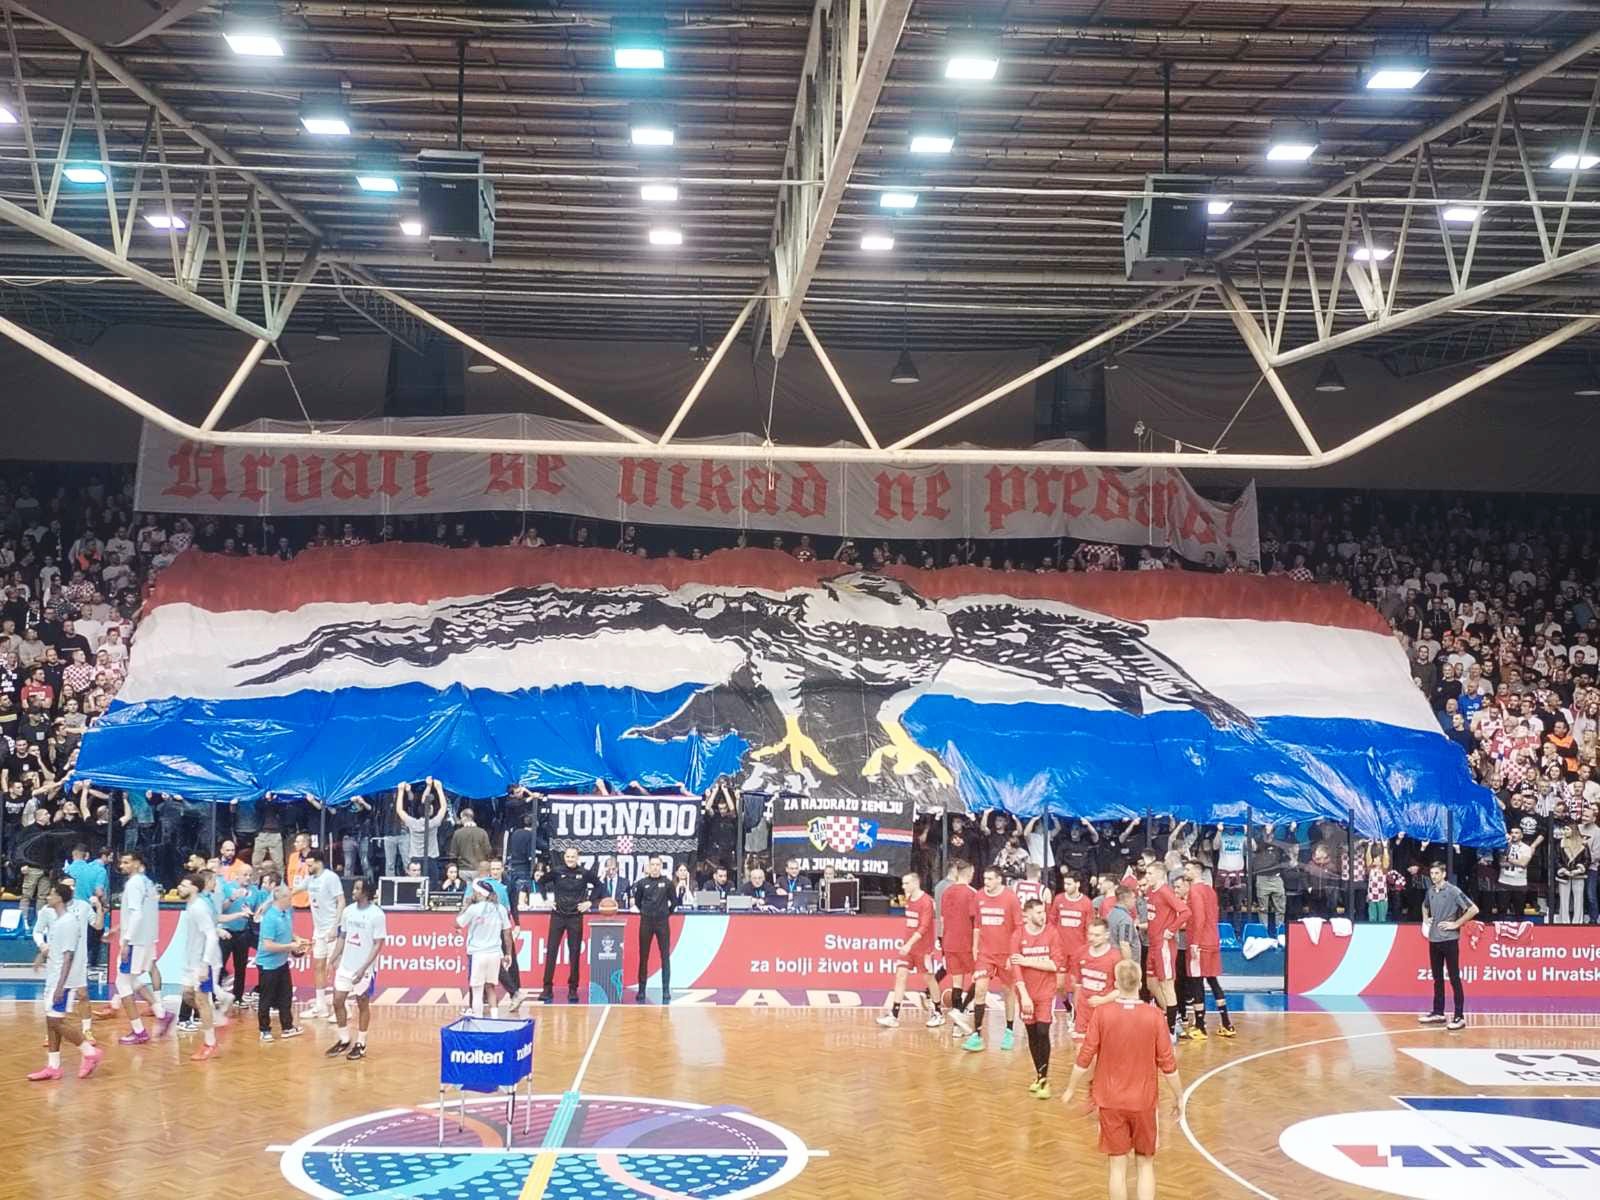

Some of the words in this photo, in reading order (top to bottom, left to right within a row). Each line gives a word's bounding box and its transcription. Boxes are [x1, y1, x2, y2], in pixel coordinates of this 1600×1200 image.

[874, 465, 951, 522] ne
[784, 799, 798, 811] ZA
[552, 802, 697, 836] TORNADO
[1489, 943, 1567, 959] Stvaramo
[751, 960, 769, 973] za
[776, 958, 812, 976] bolji
[817, 957, 859, 974] život
[863, 960, 874, 974] u
[1483, 965, 1522, 981] život
[1527, 969, 1537, 982] u
[450, 1050, 504, 1065] molten
